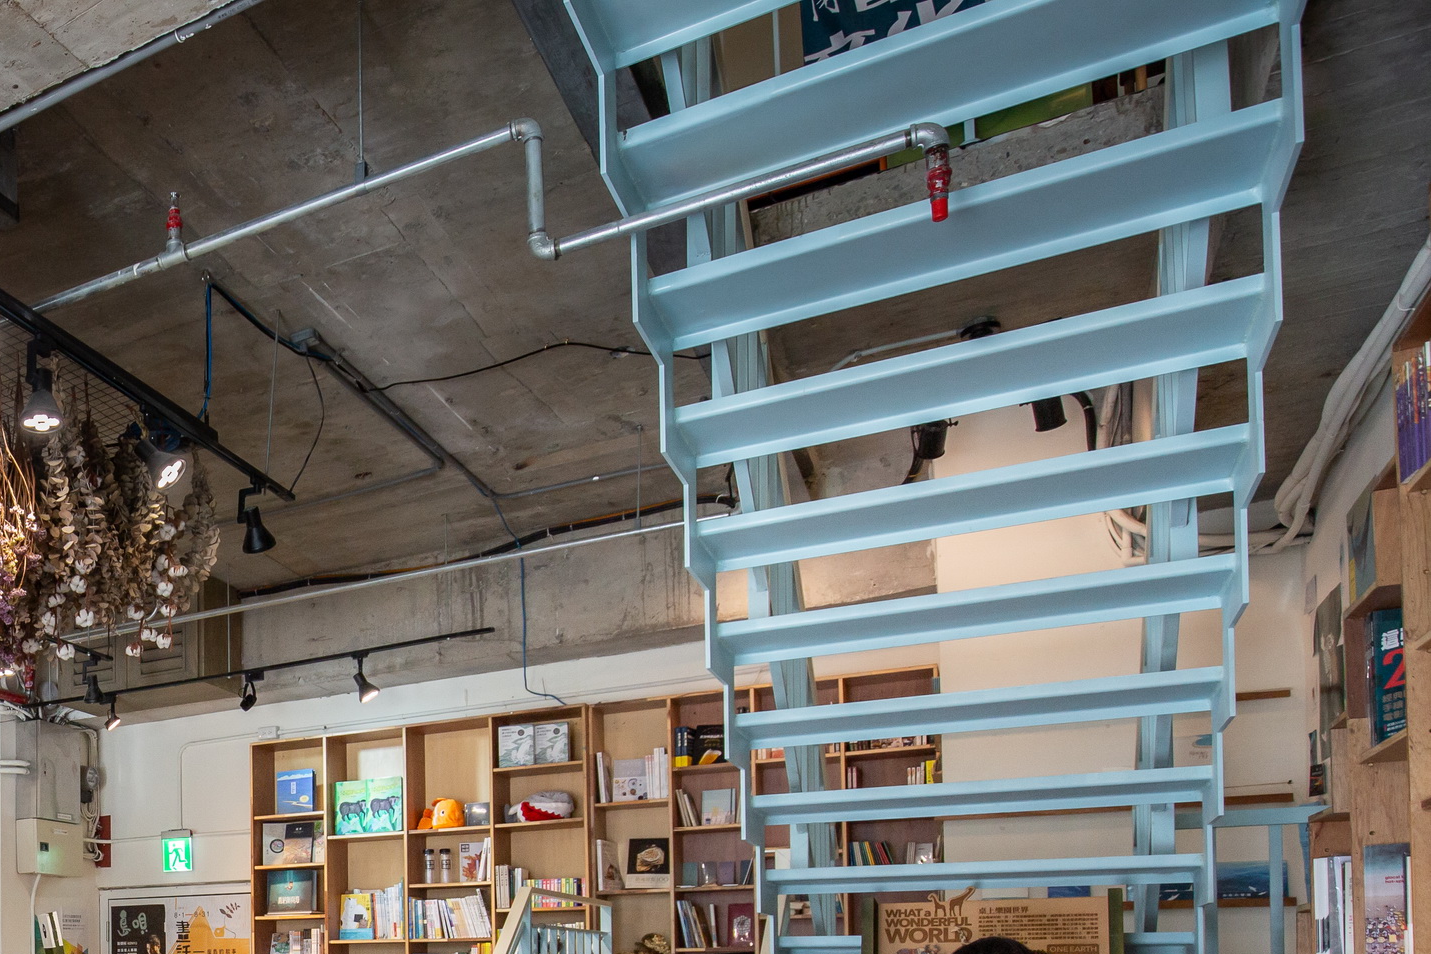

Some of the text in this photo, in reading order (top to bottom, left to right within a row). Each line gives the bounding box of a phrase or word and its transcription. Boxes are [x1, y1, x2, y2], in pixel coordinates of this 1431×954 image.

[885, 908, 923, 918] WHAT
[885, 916, 972, 927] WONDERFUL
[885, 927, 973, 944] WORLD
[1069, 945, 1098, 953] EARTH
